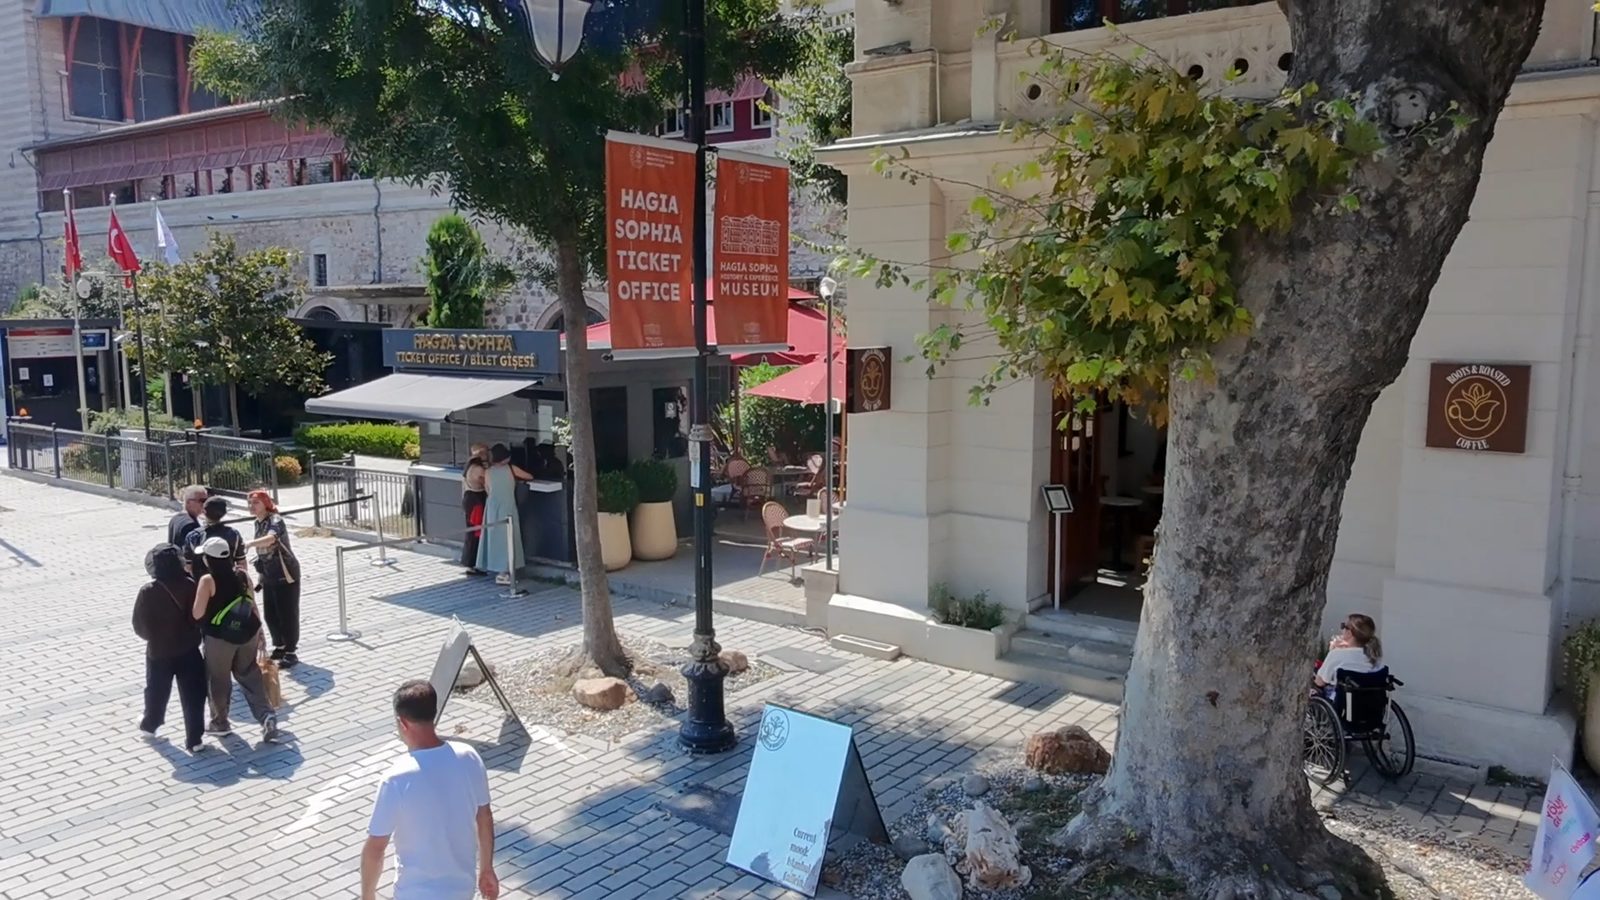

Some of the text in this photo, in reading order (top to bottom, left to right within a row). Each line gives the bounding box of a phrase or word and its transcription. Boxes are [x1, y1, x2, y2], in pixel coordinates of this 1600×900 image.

[620, 188, 678, 214] HAGIA
[615, 218, 683, 244] SOPHIA
[616, 250, 681, 273] TICKET
[720, 261, 779, 274] HAGIA SOPHIA
[720, 273, 744, 281] HISTORY
[617, 280, 681, 302] OFFICE
[720, 282, 779, 297] MUSEUM
[414, 334, 513, 351] HAGIA SOPHIA
[396, 352, 426, 363] TICKET
[428, 354, 460, 365] OFFICE
[1446, 365, 1512, 387] ROOTS & ROASTED
[1455, 437, 1490, 450] COFFEE
